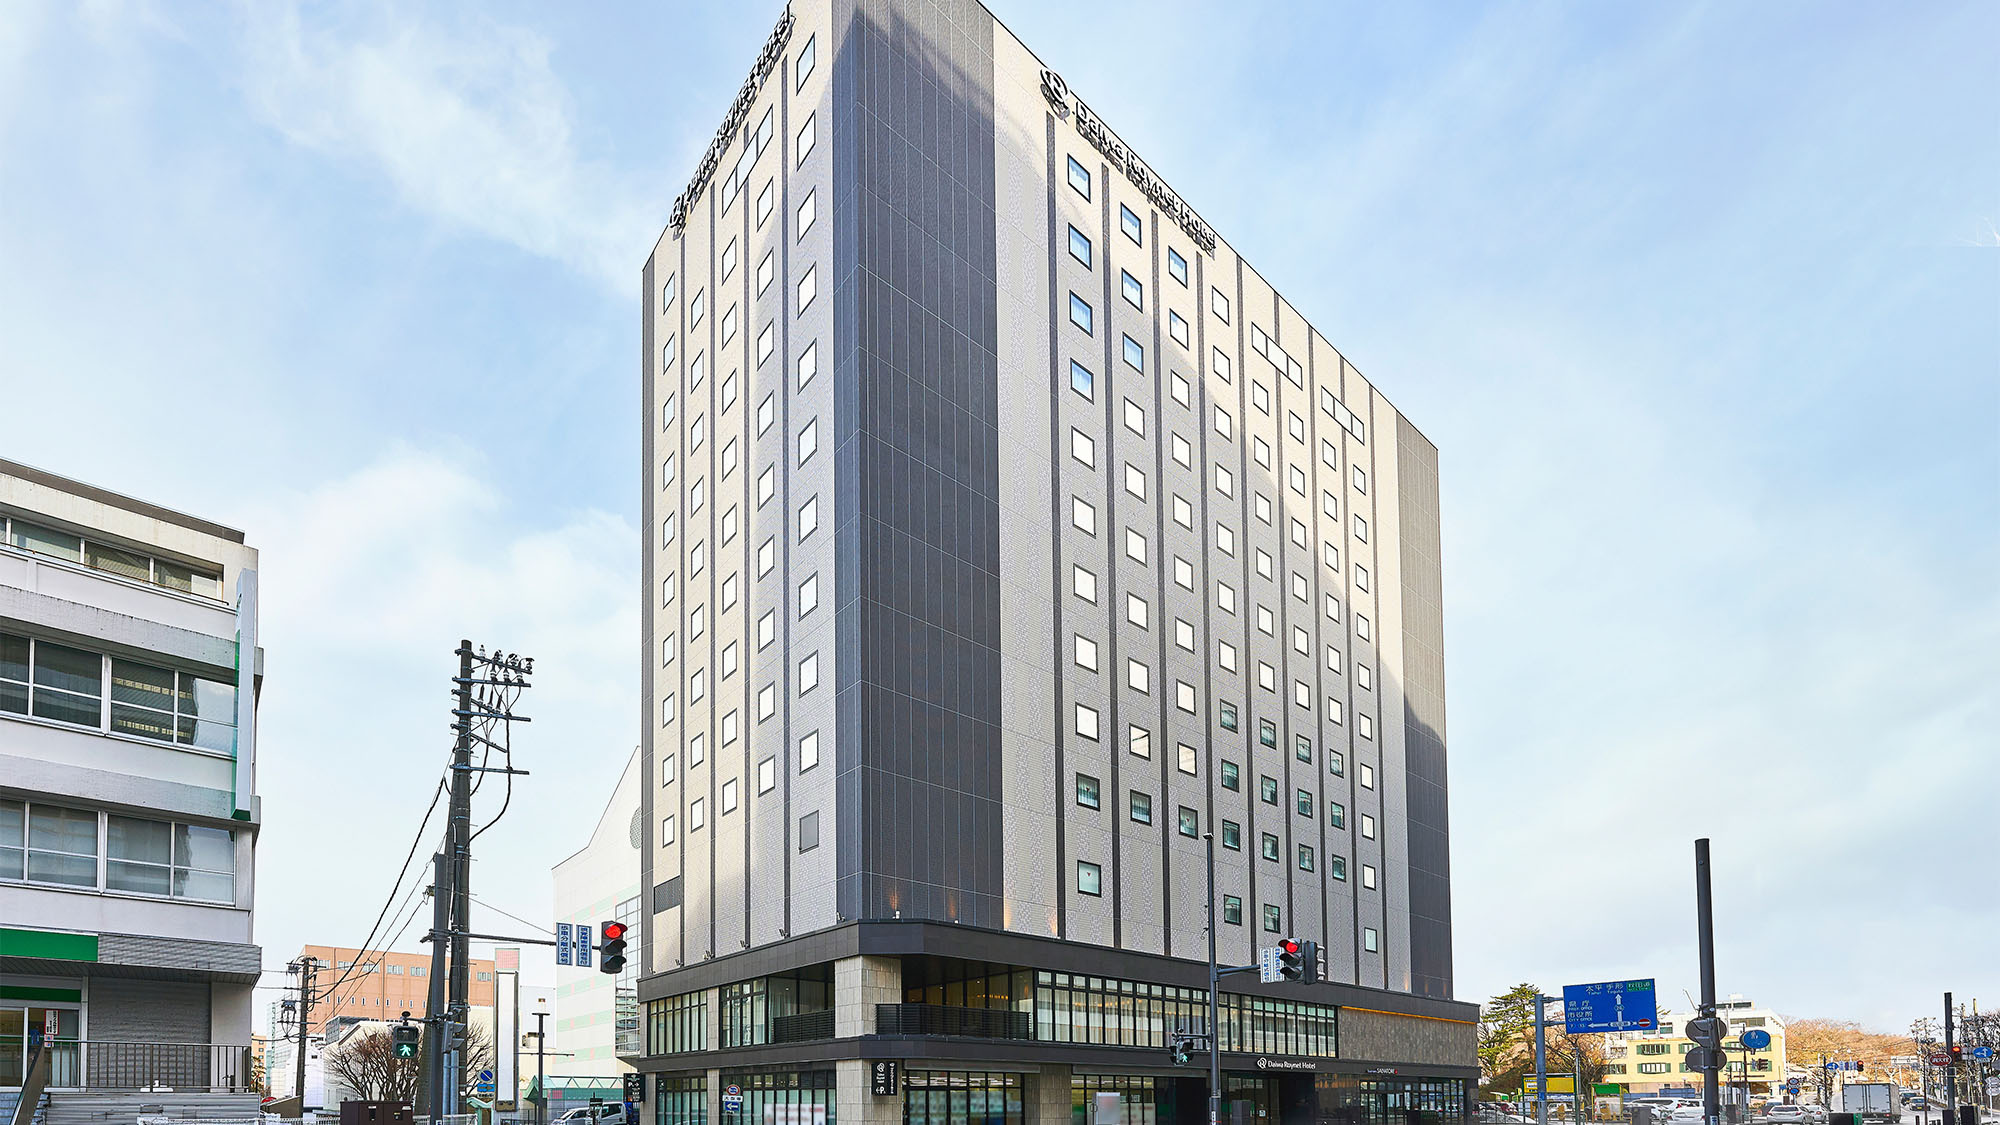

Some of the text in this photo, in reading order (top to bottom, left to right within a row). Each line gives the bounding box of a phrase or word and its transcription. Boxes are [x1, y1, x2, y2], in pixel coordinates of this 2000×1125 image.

[1075, 100, 1217, 250] Daiwa Roynet Hotel
[1284, 1061, 1302, 1070] Roynet
[1302, 1062, 1316, 1070] Hotel
